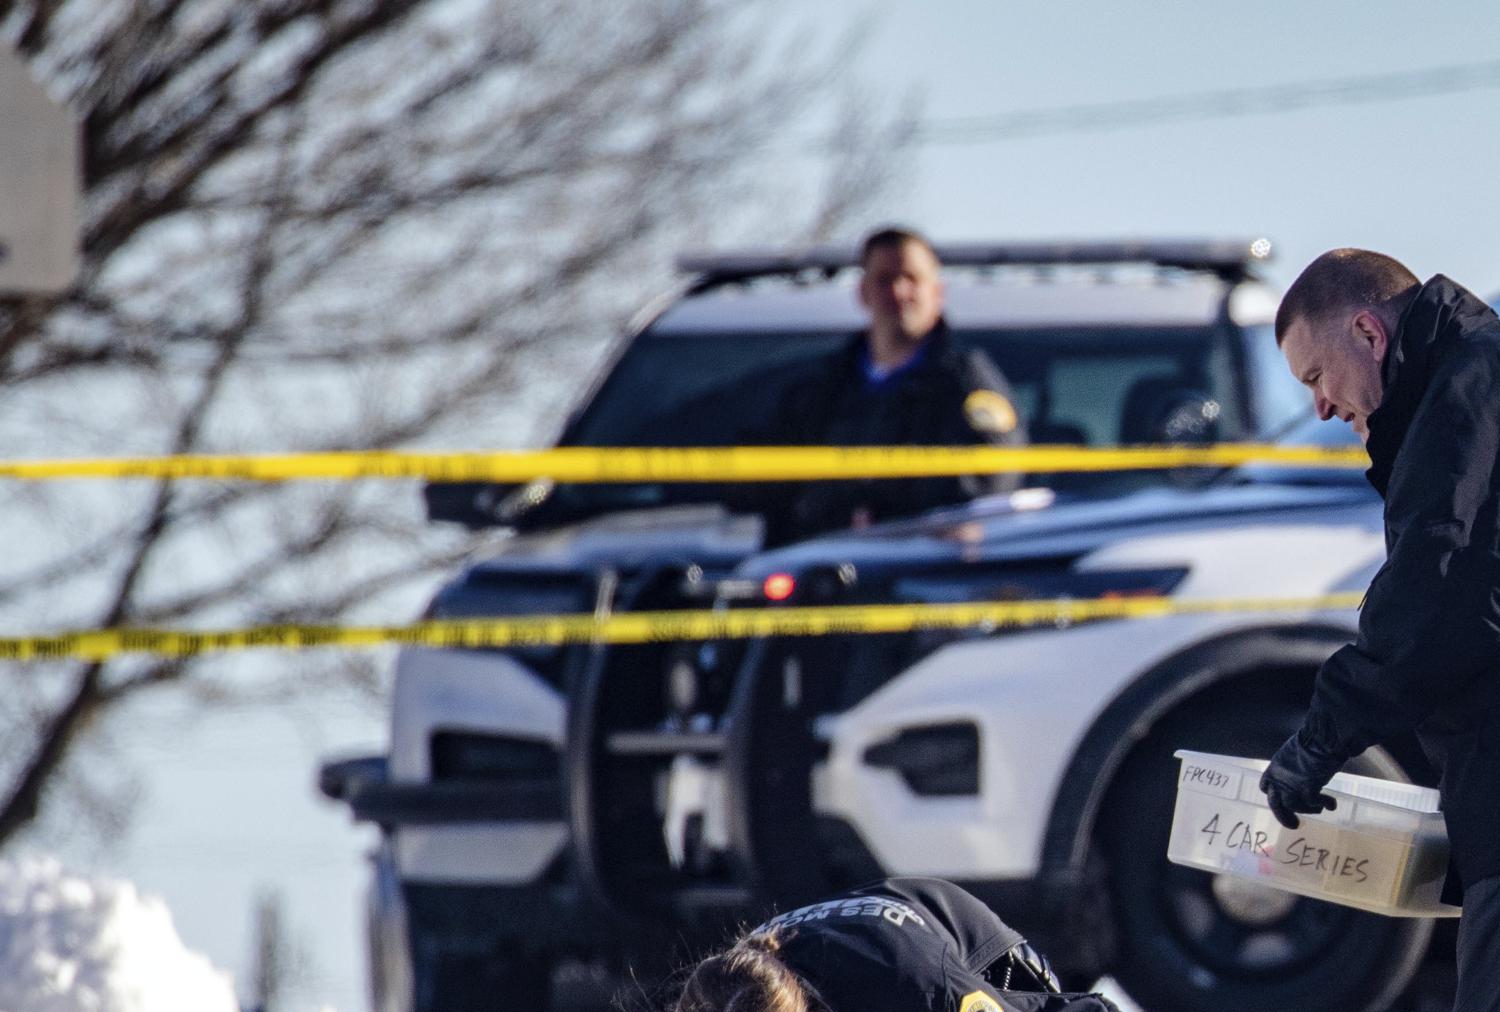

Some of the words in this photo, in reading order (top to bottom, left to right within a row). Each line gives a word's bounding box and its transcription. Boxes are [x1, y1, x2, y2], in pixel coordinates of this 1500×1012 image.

[1201, 813, 1222, 845] 4
[1226, 821, 1269, 857] CAR
[1281, 837, 1369, 882] SERIES
[841, 904, 907, 926] DES
